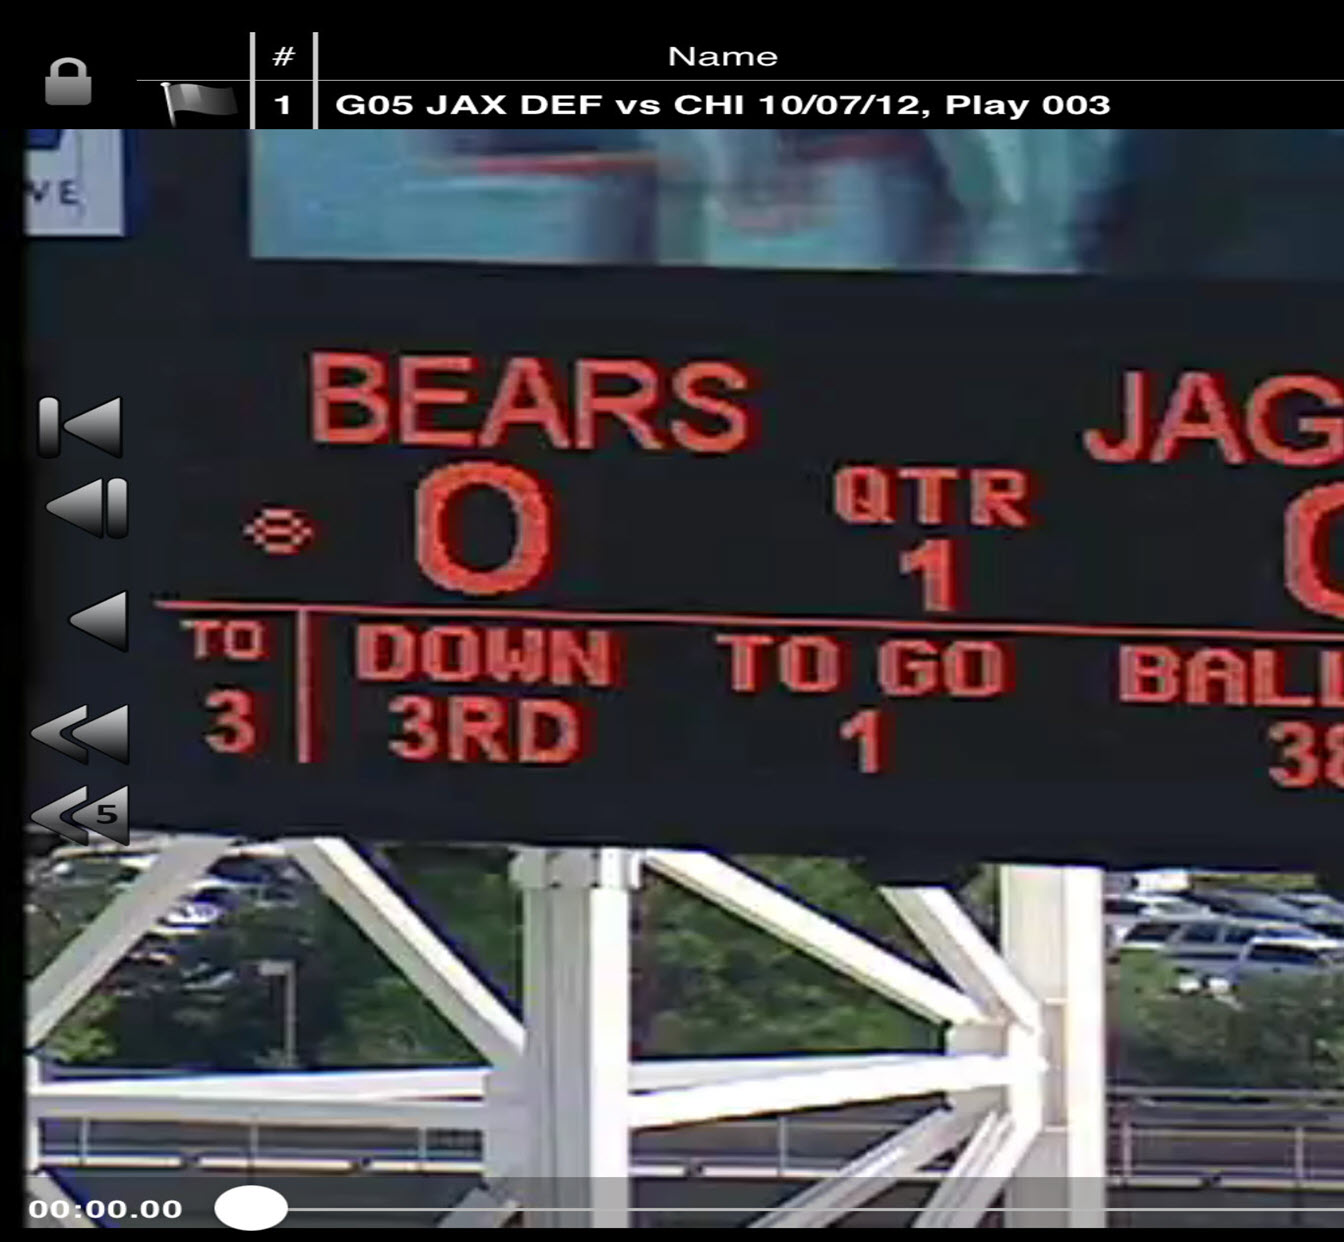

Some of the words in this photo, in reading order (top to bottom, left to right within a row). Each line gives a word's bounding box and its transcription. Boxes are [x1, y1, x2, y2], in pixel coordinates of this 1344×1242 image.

[310, 351, 750, 453] BEARS
[414, 460, 552, 596] 0
[835, 465, 1028, 527] QTR
[899, 538, 955, 612] 1
[180, 619, 265, 660] TO
[355, 623, 614, 687] DOWN
[715, 633, 839, 694] TO
[878, 638, 1004, 699] GO
[204, 688, 257, 755] 3
[388, 694, 581, 764] 3RD
[839, 709, 882, 774] 1
